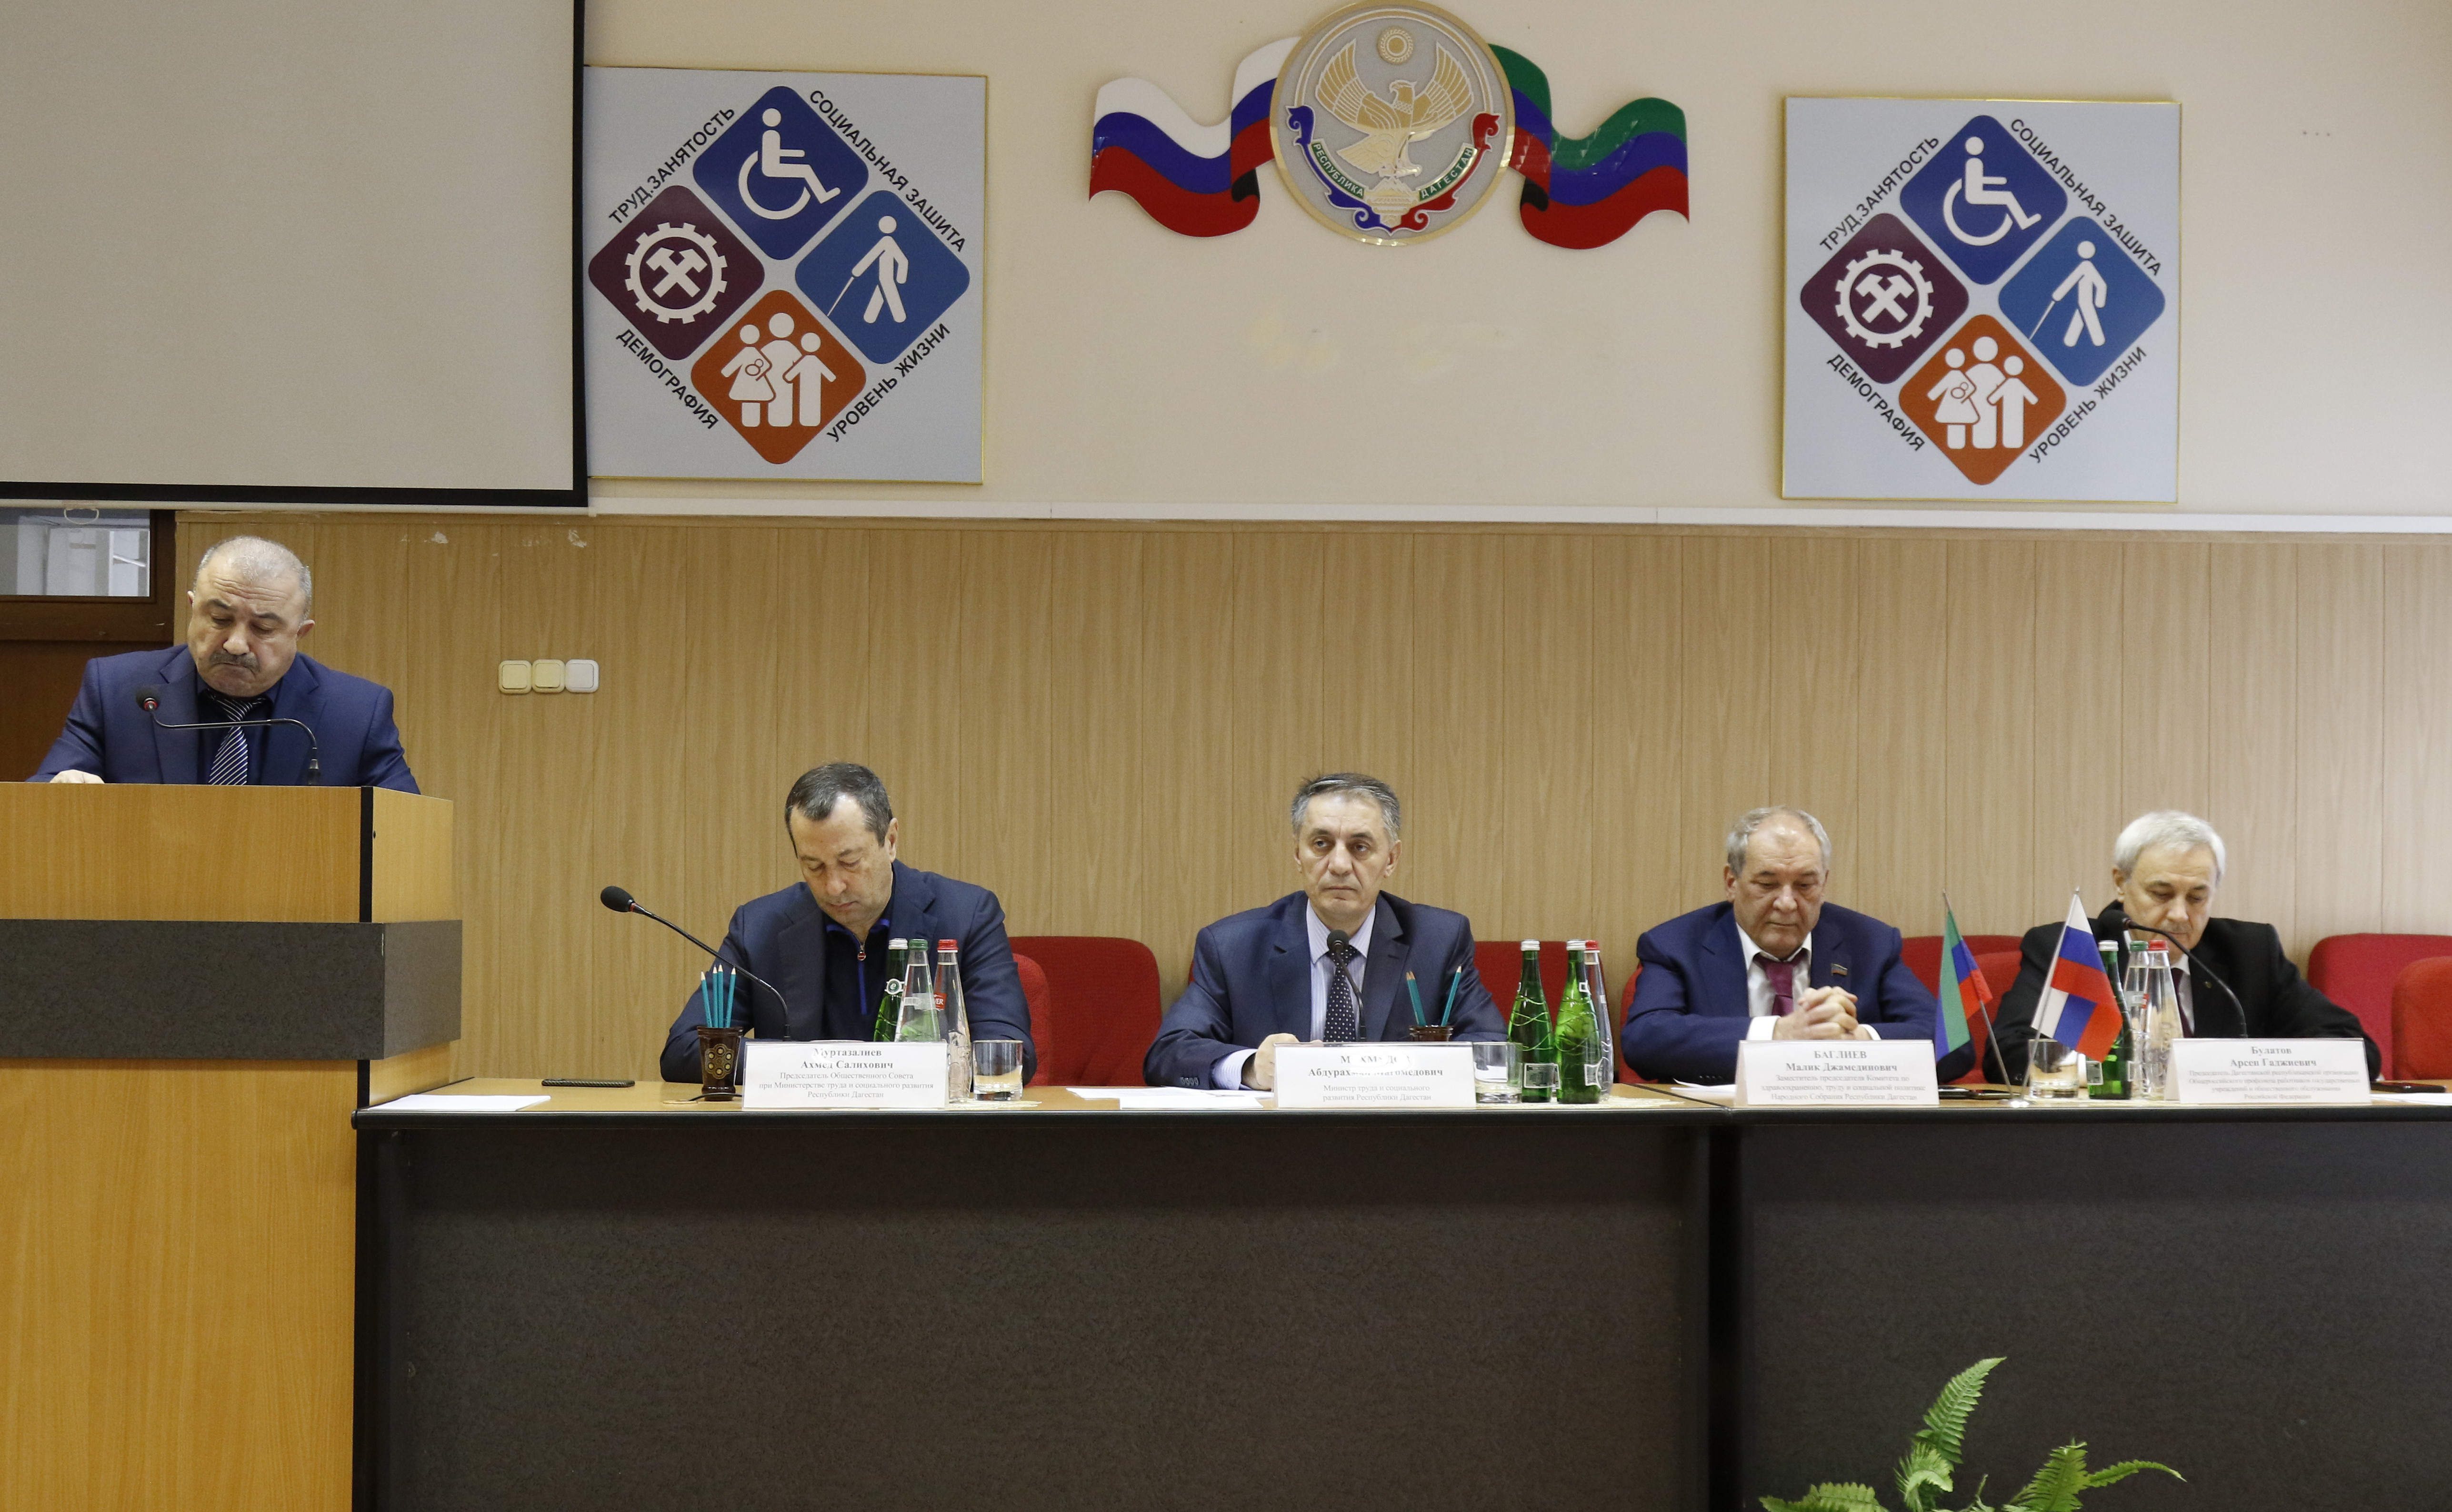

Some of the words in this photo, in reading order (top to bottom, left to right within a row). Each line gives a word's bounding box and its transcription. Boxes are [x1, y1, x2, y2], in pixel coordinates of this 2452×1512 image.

[810, 90, 909, 191] СОЦИАЛЬНАЯ
[609, 106, 735, 225] ТРУД.ЗАНЯТОСТЬ
[1313, 143, 1364, 197] РЕСПУБЛИКА
[2011, 119, 2107, 216] СОЦИАЛЬНАЯ
[1421, 148, 1472, 198] ДАГЕСТАН
[1820, 135, 1940, 252] ТРУД.ЗАНЯТОСТЬ
[616, 328, 720, 429] ДЕМОГРАФИЯ
[826, 377, 898, 442] УРОВЕНЬ
[894, 323, 950, 379] ЖИЗНИ
[1827, 354, 1925, 452] ДЕМОГРАФИЯ
[2029, 399, 2097, 464] УРОВЕНЬ
[2093, 346, 2147, 401] ЖИЗНИ
[814, 1048, 882, 1058] Муртазалиев
[1814, 1050, 1867, 1059] БАГЛИЕВ
[2251, 1046, 2292, 1056] Булатов
[801, 1061, 832, 1069] Ахмед
[836, 1060, 893, 1069] Салихович
[1786, 1063, 1821, 1071] Малик
[1823, 1063, 1898, 1072] Джамединович
[2231, 1059, 2260, 1069] Арсен
[2262, 1058, 2317, 1067] Гаджиевич
[831, 1072, 887, 1080] Общественного
[1308, 1068, 1370, 1079] Абдурах
[774, 1082, 825, 1090] Министерстве
[1323, 1084, 1356, 1093] Министр
[808, 1091, 850, 1099] Республики
[1357, 1094, 1398, 1102] Республики
[1771, 1093, 1808, 1101] Народного
[1810, 1093, 1843, 1101] Собрания
[1845, 1093, 1885, 1102] Республики
